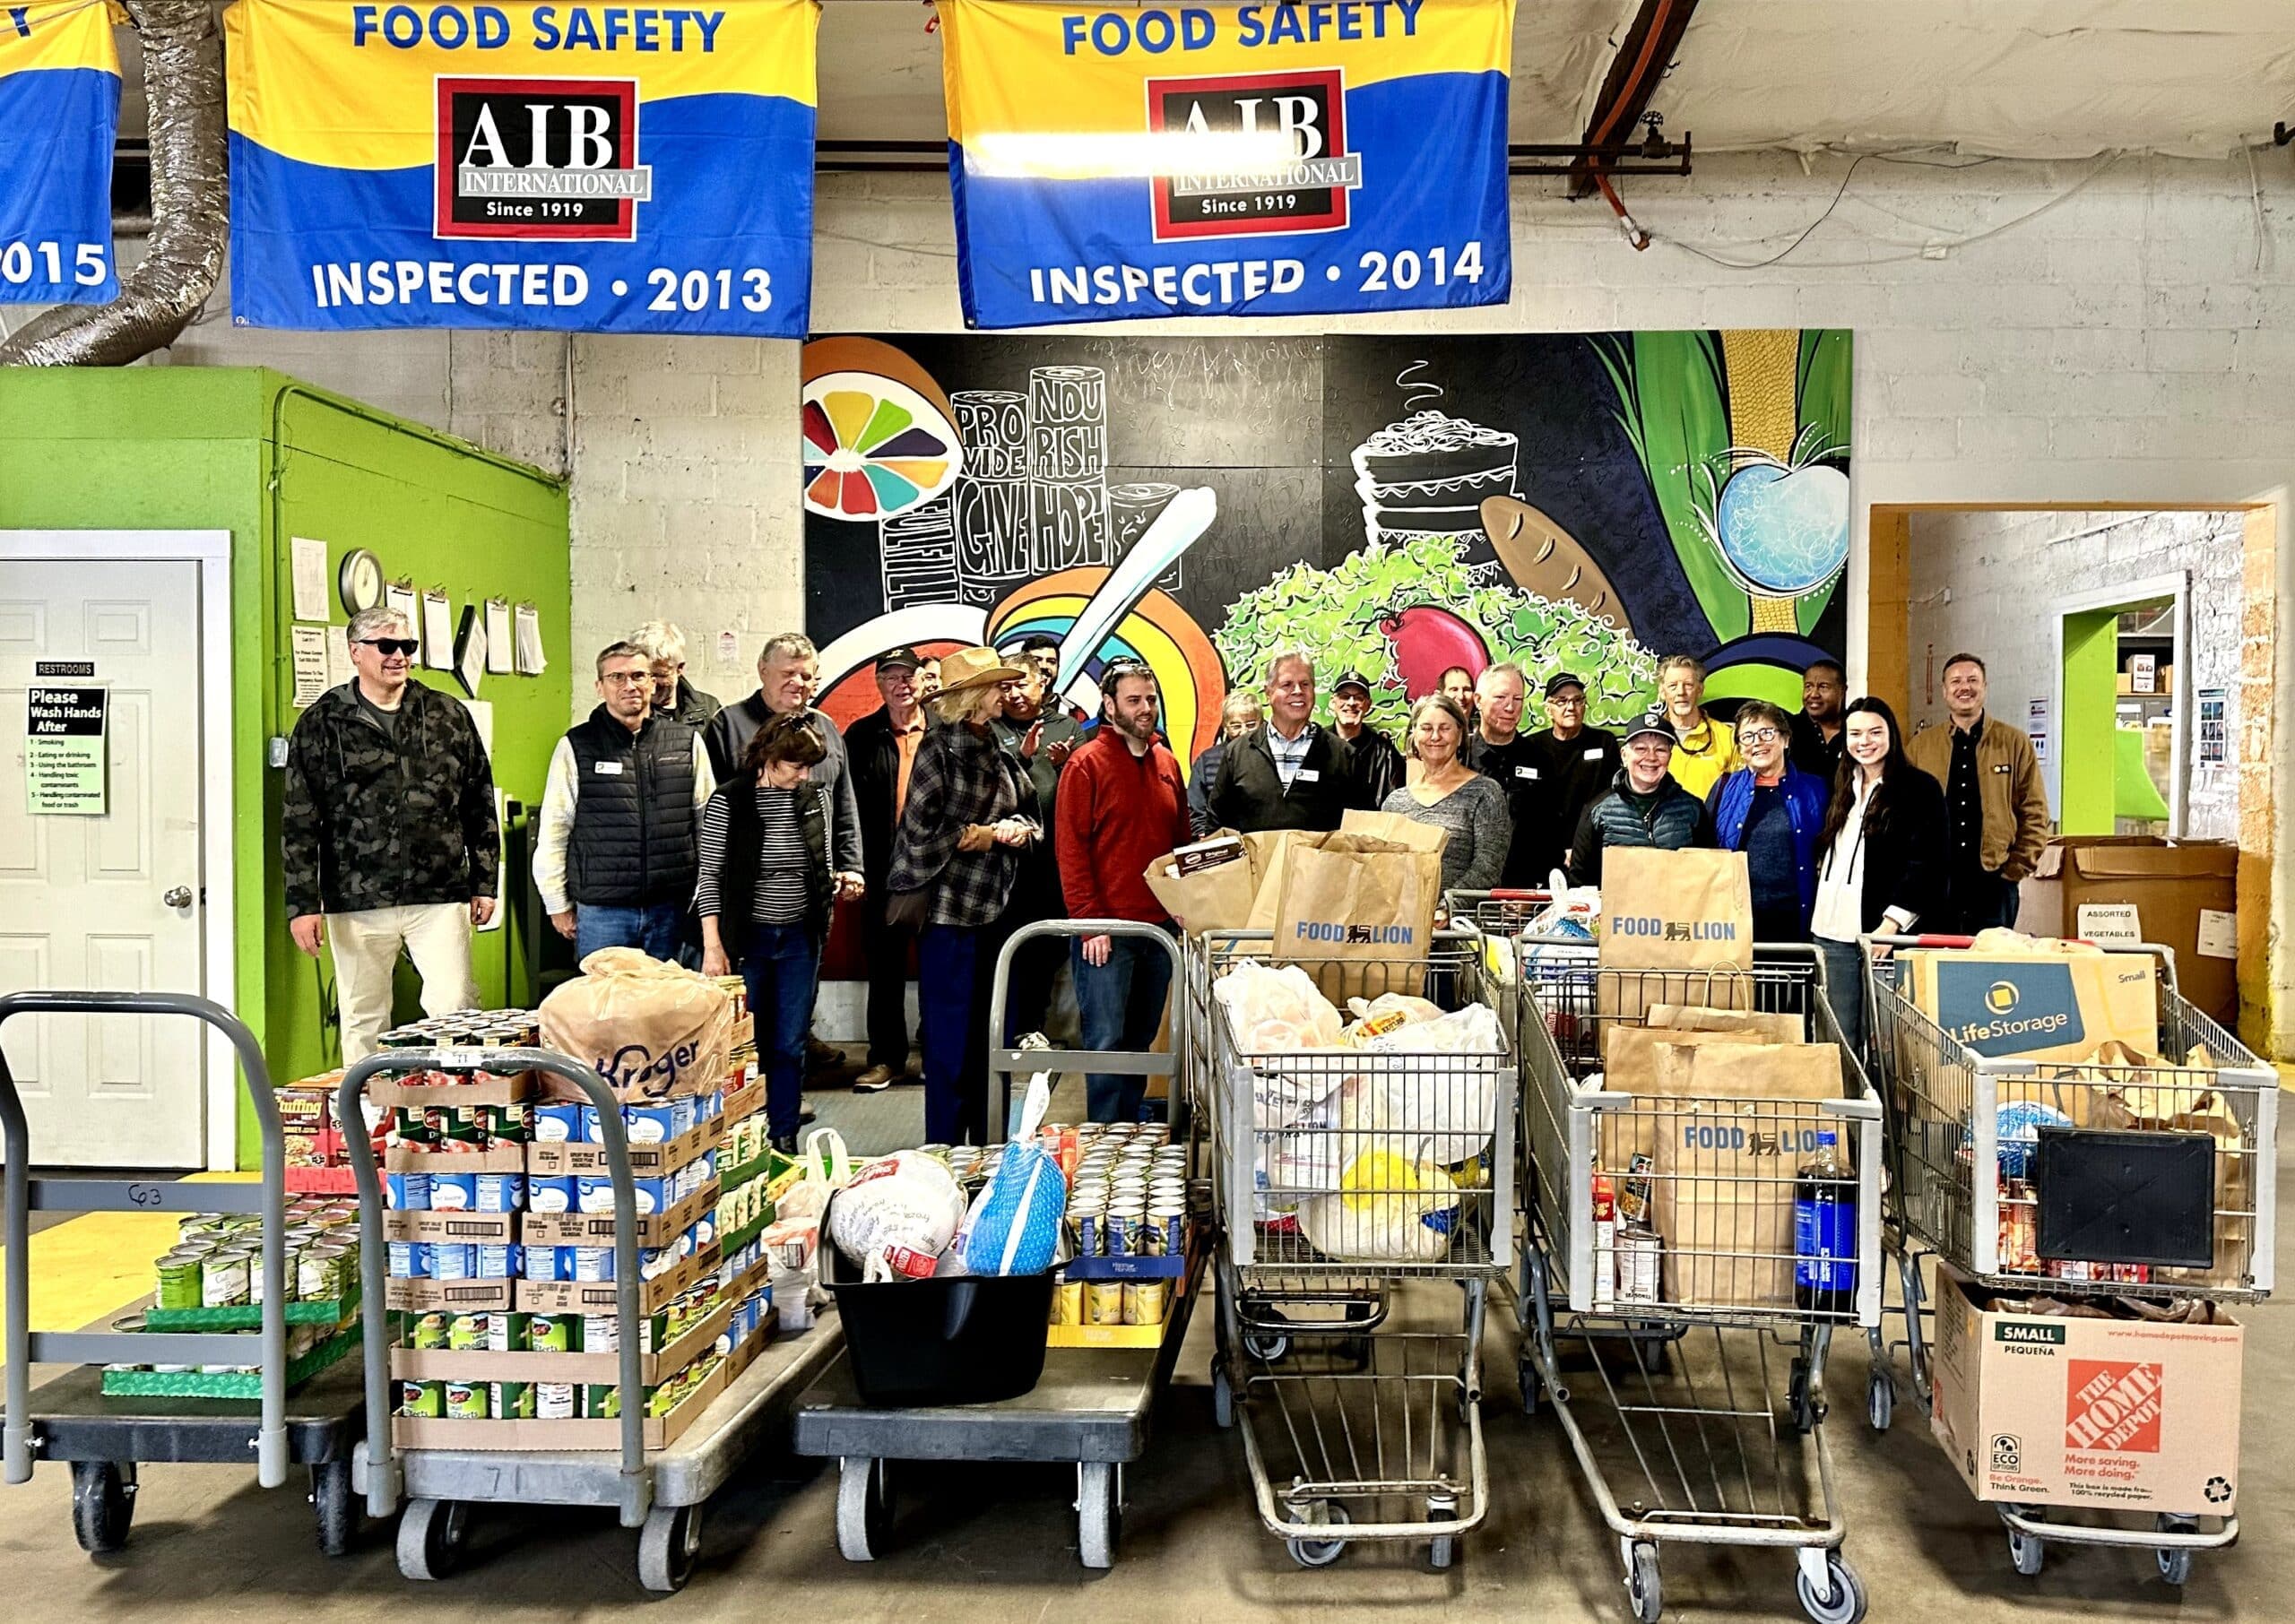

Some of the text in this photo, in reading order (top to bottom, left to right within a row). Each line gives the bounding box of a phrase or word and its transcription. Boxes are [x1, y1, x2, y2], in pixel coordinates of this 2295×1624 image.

[354, 5, 725, 52] FOOD SAFETY
[1063, 0, 1423, 56] FOOD SAFETY
[459, 103, 614, 169] AIB
[1182, 96, 1322, 160] AIB
[464, 170, 642, 196] INTERNATIONAL
[486, 201, 584, 218] Since 1919
[1201, 194, 1297, 214] Since 1919
[0, 241, 107, 286] 015
[1031, 240, 1485, 307] INSPECTED 2014
[313, 263, 773, 313] INSPECTED 2013
[1033, 379, 1103, 424] NOU
[956, 403, 1025, 449] PRO
[964, 447, 1026, 478] VIDE
[1034, 425, 1104, 479] RISH
[960, 479, 1029, 576] GIVE
[1033, 483, 1104, 575] HOPE
[39, 664, 91, 674] RESTROOMS
[30, 689, 79, 704] Please
[30, 706, 102, 718] Wash Hands
[36, 720, 67, 732] After
[38, 739, 65, 747] Smoking
[65, 752, 91, 760] drinking
[1296, 921, 1412, 945] FOOD LION
[1612, 917, 1736, 941] FOOD LION
[2118, 971, 2145, 983] Small
[1950, 1013, 2067, 1043] LifeStorage
[596, 1040, 699, 1098] Kroger
[1684, 1127, 1819, 1153] FOOD LIO
[2004, 1326, 2055, 1342] SMALL
[2108, 1329, 2239, 1343] www.homedepotmoving.com
[2005, 1345, 2056, 1357] PEQUEÑA
[2075, 1369, 2117, 1406] THE
[2066, 1362, 2162, 1449] HOME
[2101, 1396, 2161, 1451] DEPOT
[1993, 1454, 2018, 1464] ECO
[1993, 1464, 2018, 1472] OPTIONS
[2065, 1454, 2140, 1470] More saving.
[1989, 1474, 2043, 1485] Be Orange.
[2065, 1465, 2135, 1481] More doing.
[1990, 1482, 2050, 1493] Think Green.
[2094, 1490, 2126, 1499] recycled
